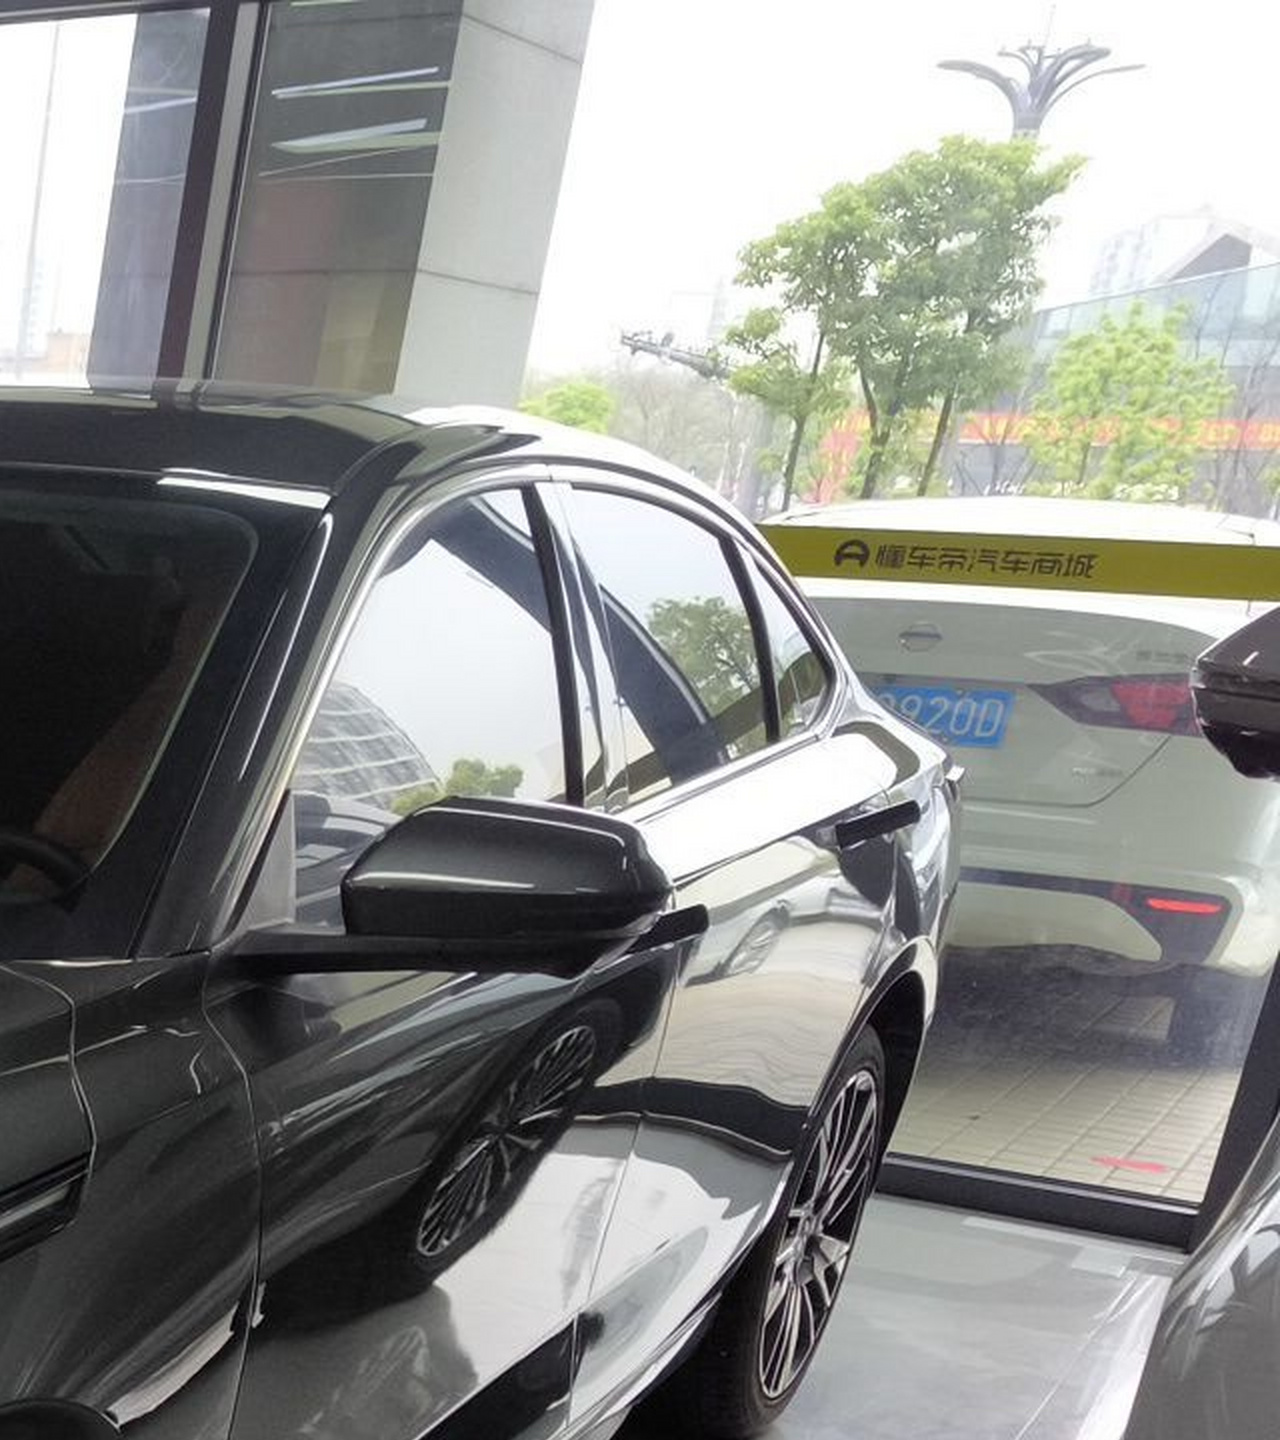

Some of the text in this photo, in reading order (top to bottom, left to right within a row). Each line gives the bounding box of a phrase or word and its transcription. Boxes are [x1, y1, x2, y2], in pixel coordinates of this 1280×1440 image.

[875, 543, 1099, 579] 懂车帝汽车商城
